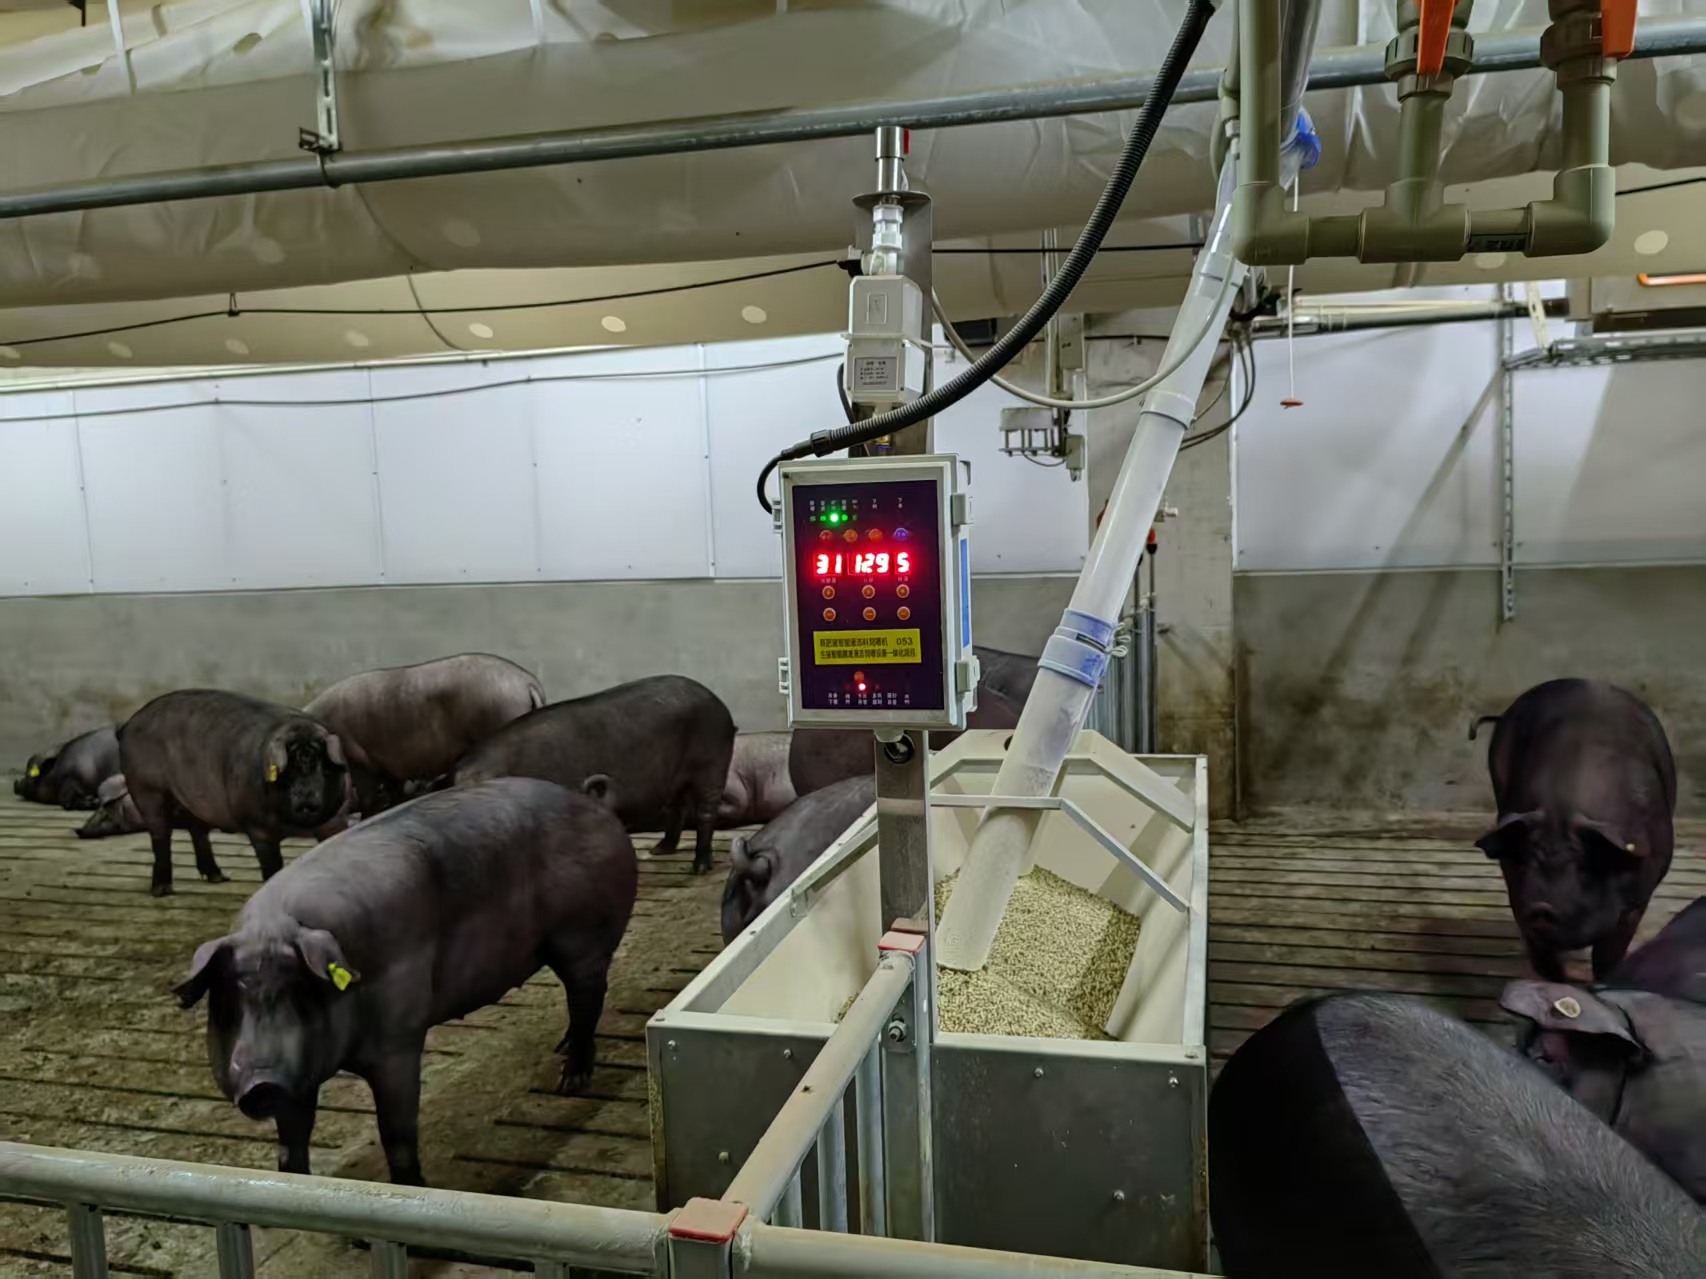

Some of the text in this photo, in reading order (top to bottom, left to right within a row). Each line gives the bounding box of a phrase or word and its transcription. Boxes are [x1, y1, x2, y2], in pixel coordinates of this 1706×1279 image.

[816, 554, 842, 574] 31
[897, 552, 910, 573] 5
[896, 637, 913, 646] 053
